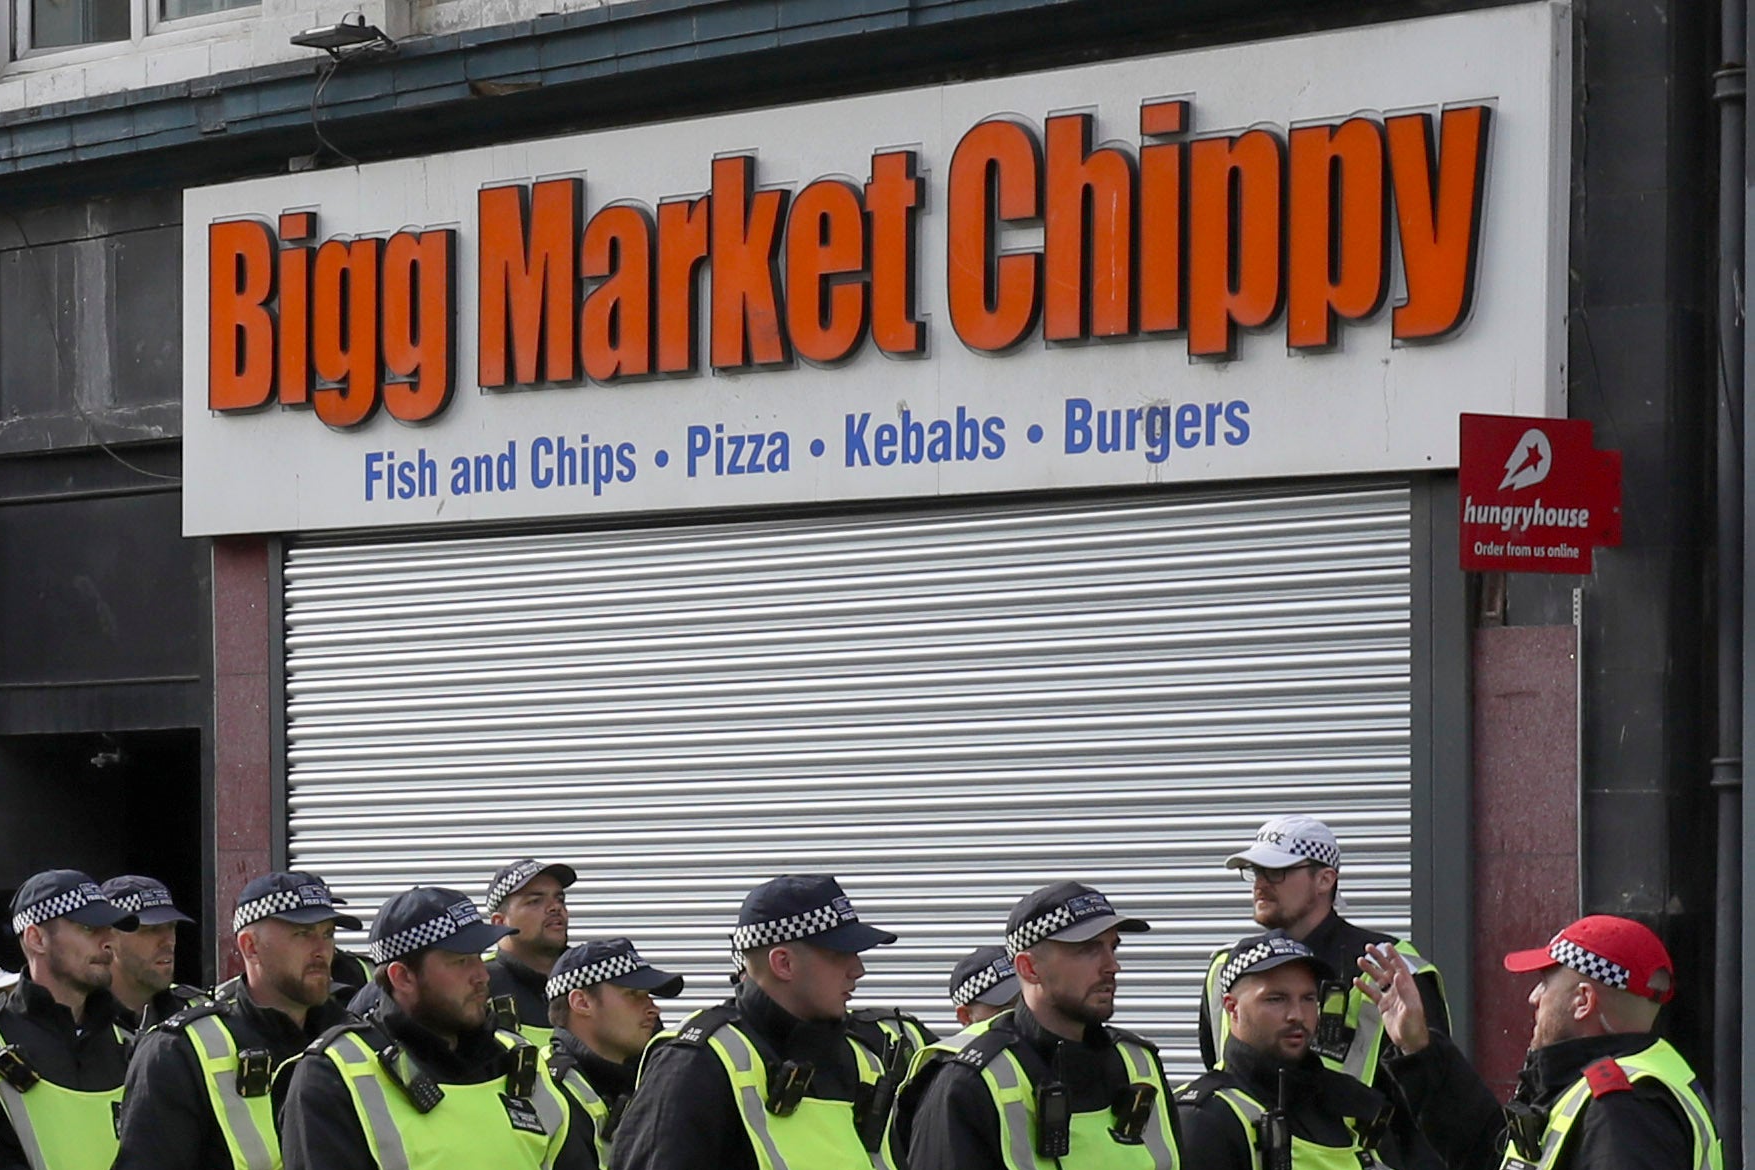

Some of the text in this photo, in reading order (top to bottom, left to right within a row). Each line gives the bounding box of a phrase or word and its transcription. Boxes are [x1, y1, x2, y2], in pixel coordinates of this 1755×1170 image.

[209, 100, 1491, 428] Bigg Market Chippy
[365, 397, 1252, 501] Fish and Chips Pizza Kebabs Burgers
[1463, 495, 1590, 532] hungryhouse
[1473, 541, 1579, 558] Order from us online
